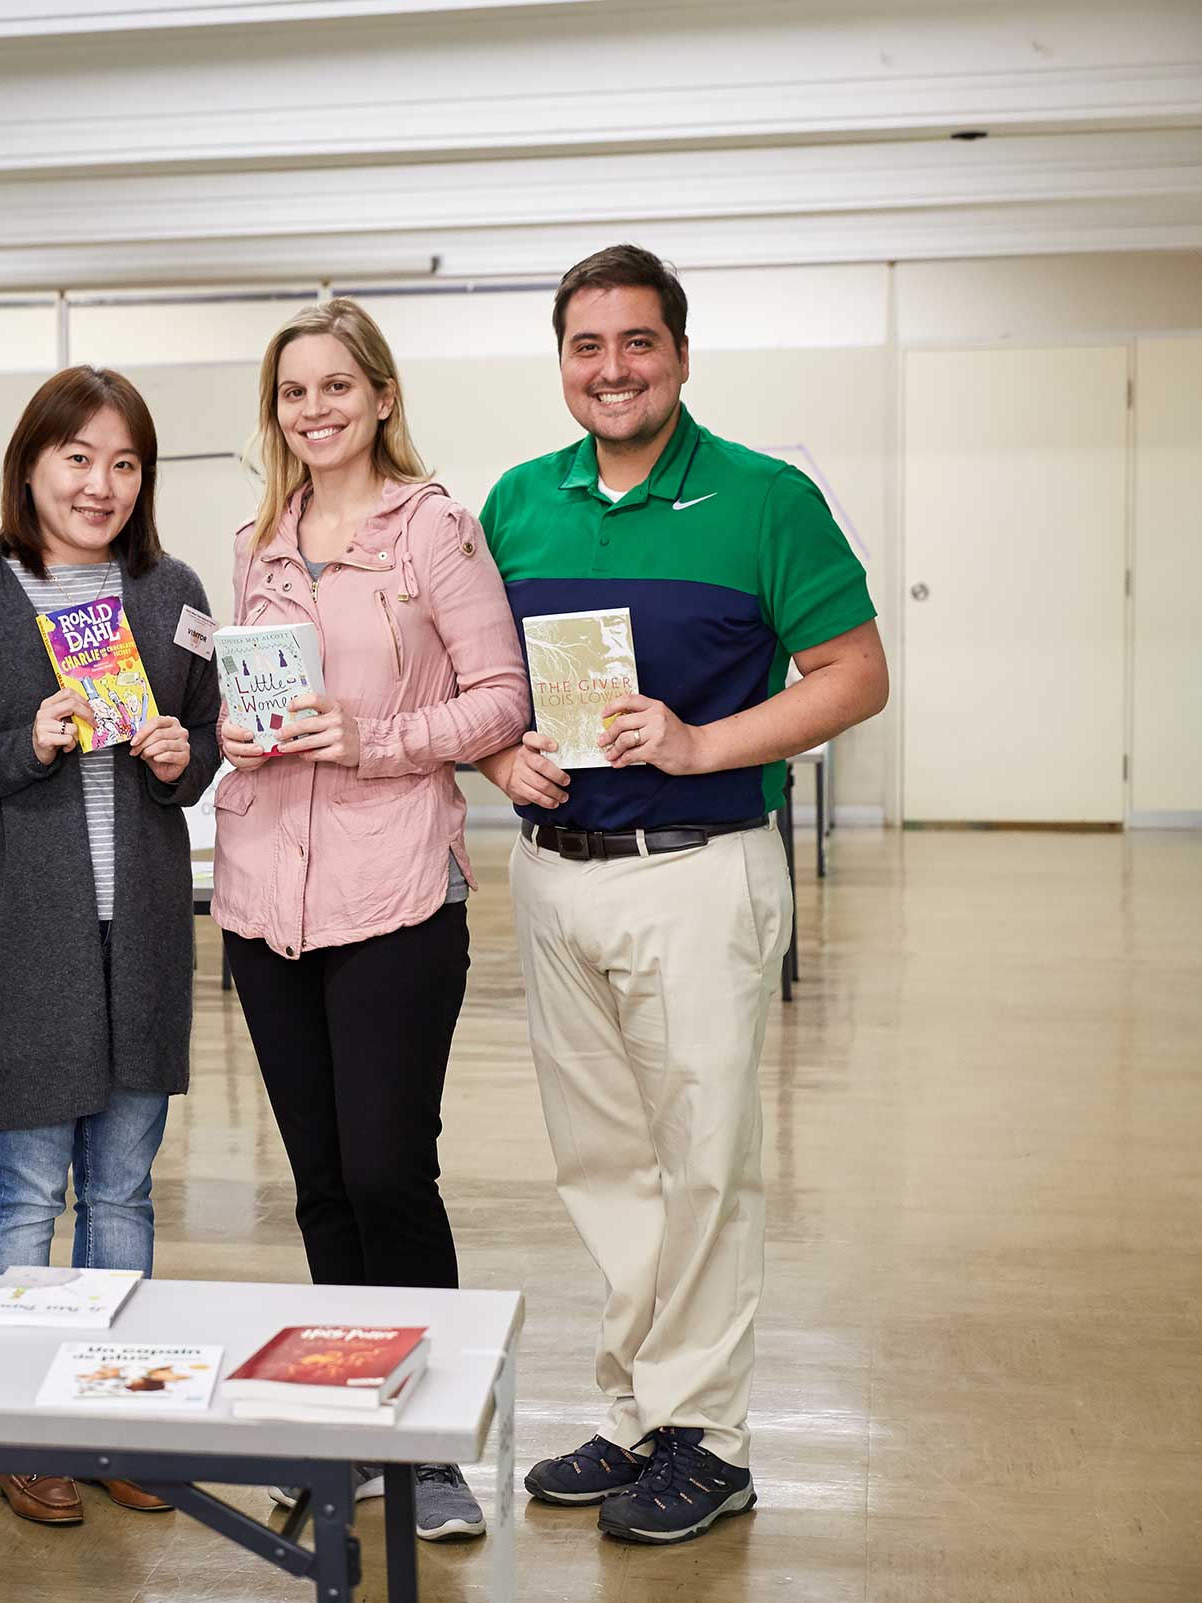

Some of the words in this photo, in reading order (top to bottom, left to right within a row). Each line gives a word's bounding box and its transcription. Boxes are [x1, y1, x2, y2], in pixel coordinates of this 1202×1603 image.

[58, 603, 113, 634] ROALD
[64, 621, 121, 653] DAHL
[262, 632, 289, 641] ALCOTT
[61, 648, 101, 673] CHARLIE
[539, 680, 571, 694] THE
[578, 676, 633, 692] GIVER
[541, 694, 574, 707] LOIS
[101, 1354, 150, 1362] plus
[122, 1348, 202, 1356] copain
